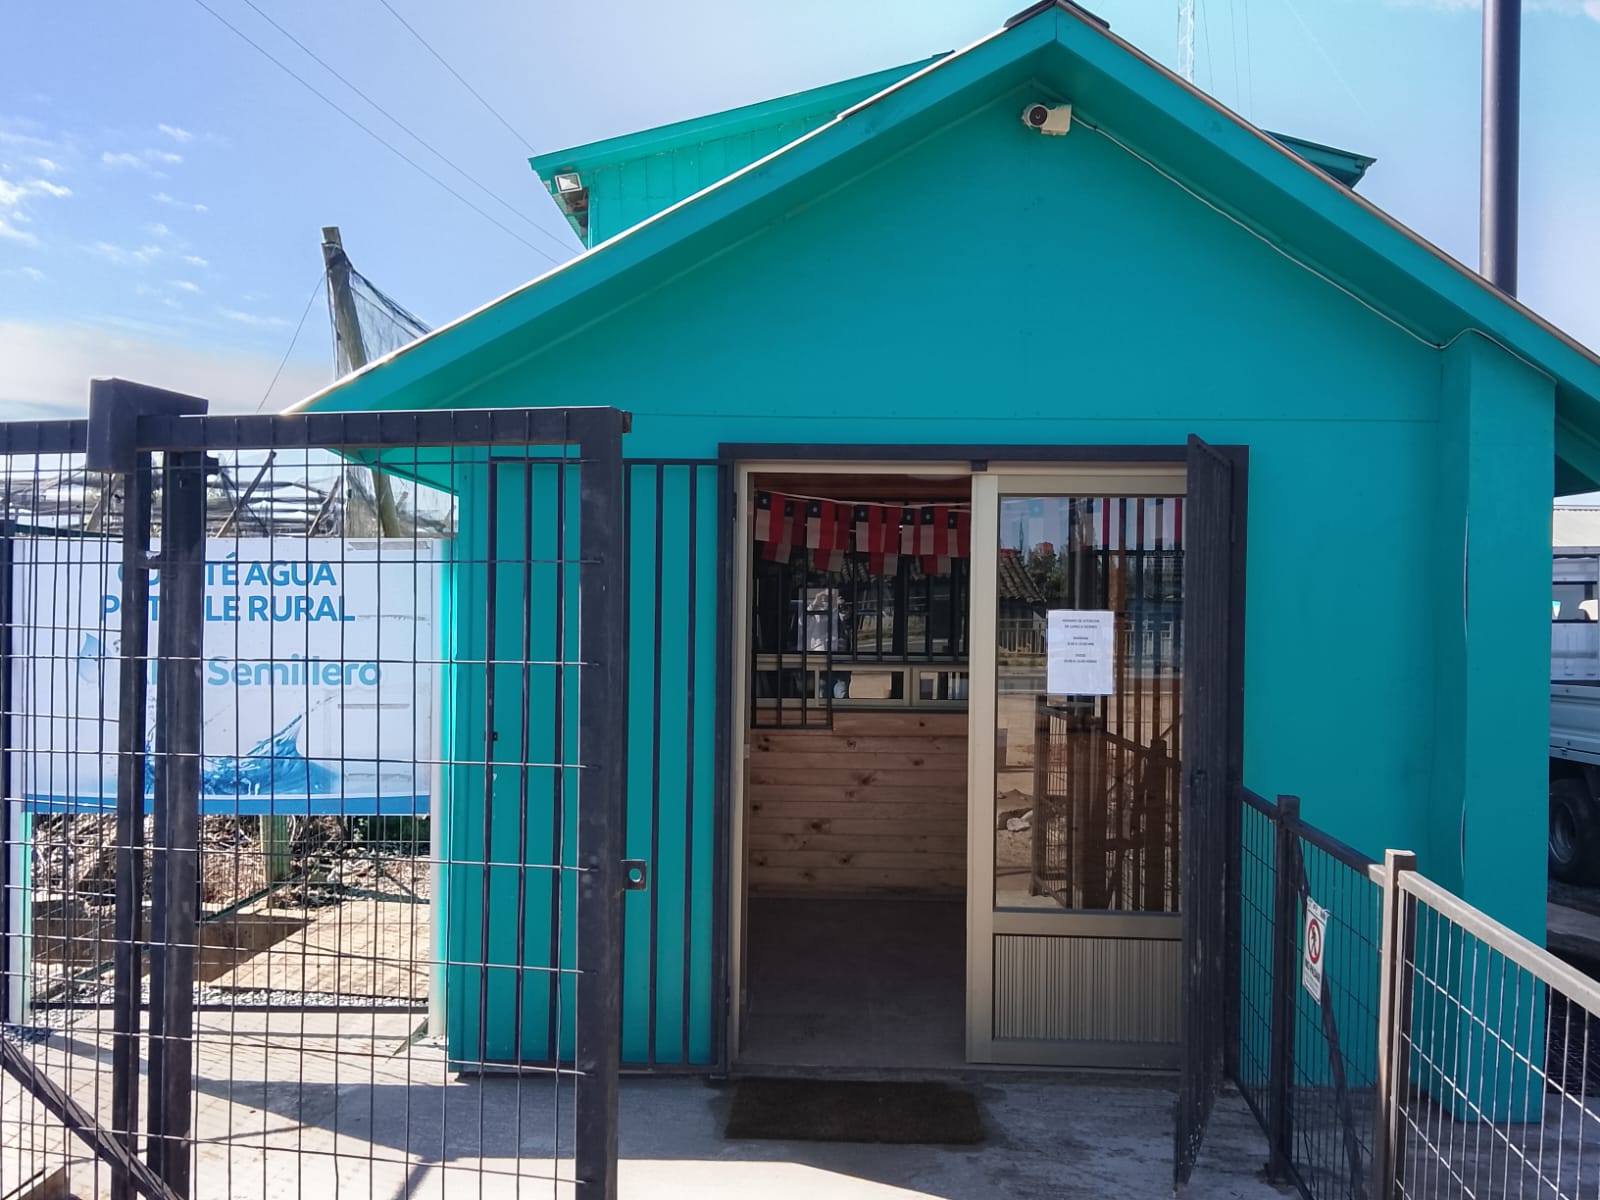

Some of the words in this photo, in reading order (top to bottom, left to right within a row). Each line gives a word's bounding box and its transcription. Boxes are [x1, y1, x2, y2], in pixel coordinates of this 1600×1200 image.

[244, 560, 337, 586] AGUA
[101, 595, 241, 622] PTLE
[248, 595, 355, 622] RURAL
[207, 653, 382, 686] Semillero
